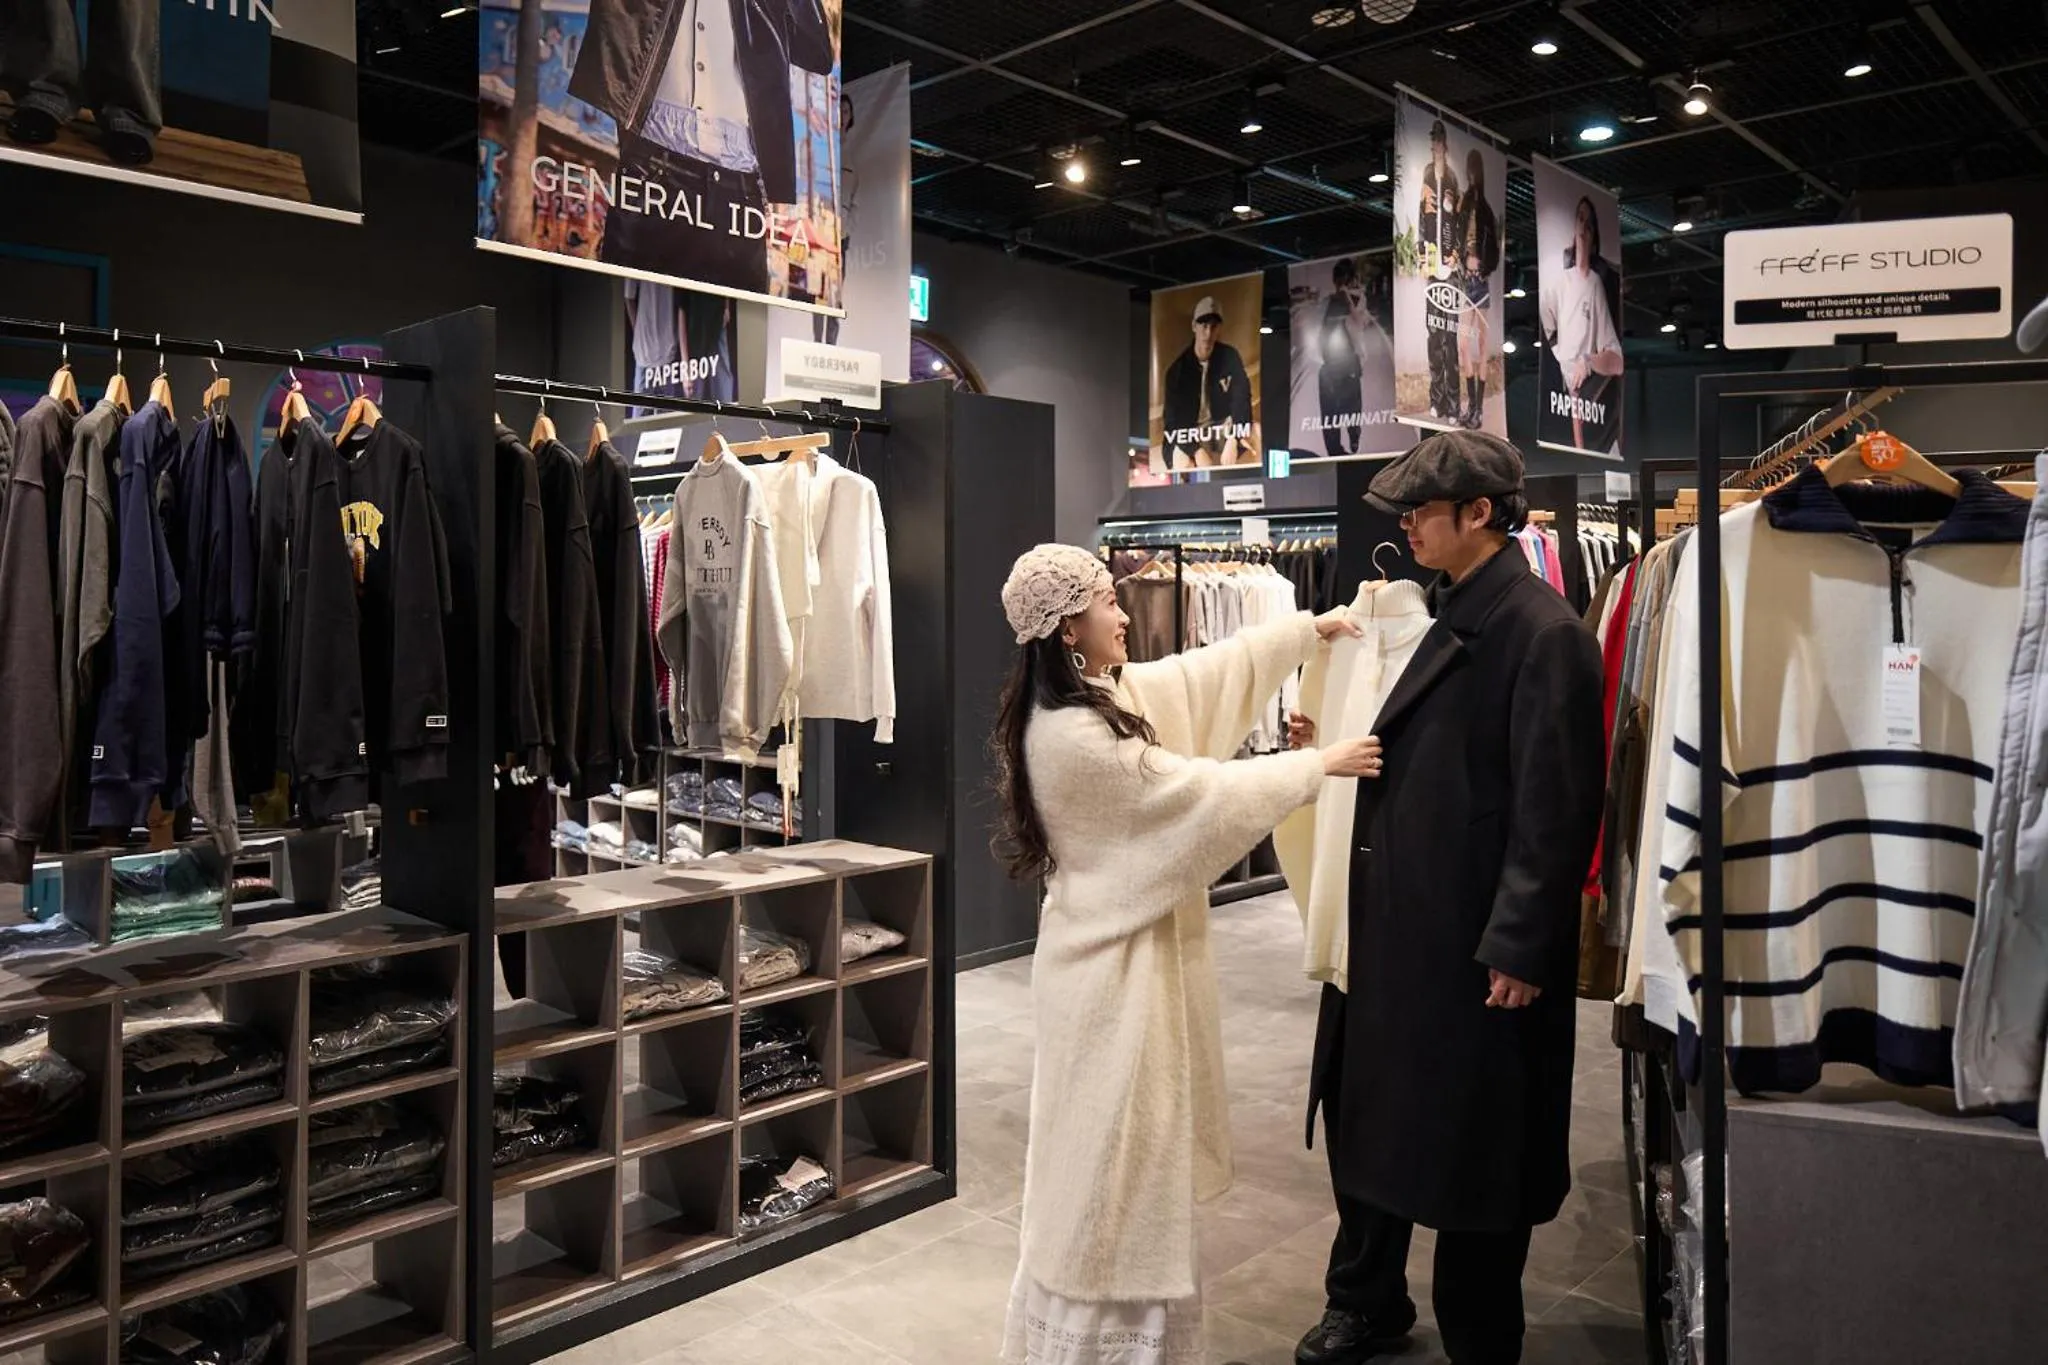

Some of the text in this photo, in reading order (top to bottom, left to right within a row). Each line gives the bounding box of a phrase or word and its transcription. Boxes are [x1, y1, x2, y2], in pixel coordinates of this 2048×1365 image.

[530, 155, 810, 251] GENERAL IDEA
[1869, 246, 1982, 270] STUDIO
[1781, 292, 1950, 309] Modern silhouette and unique details
[645, 354, 719, 389] PAPERBOY
[1550, 391, 1606, 425] PAPERBOY
[1164, 422, 1252, 445] VERUTUM
[1888, 661, 1914, 671] HAN
